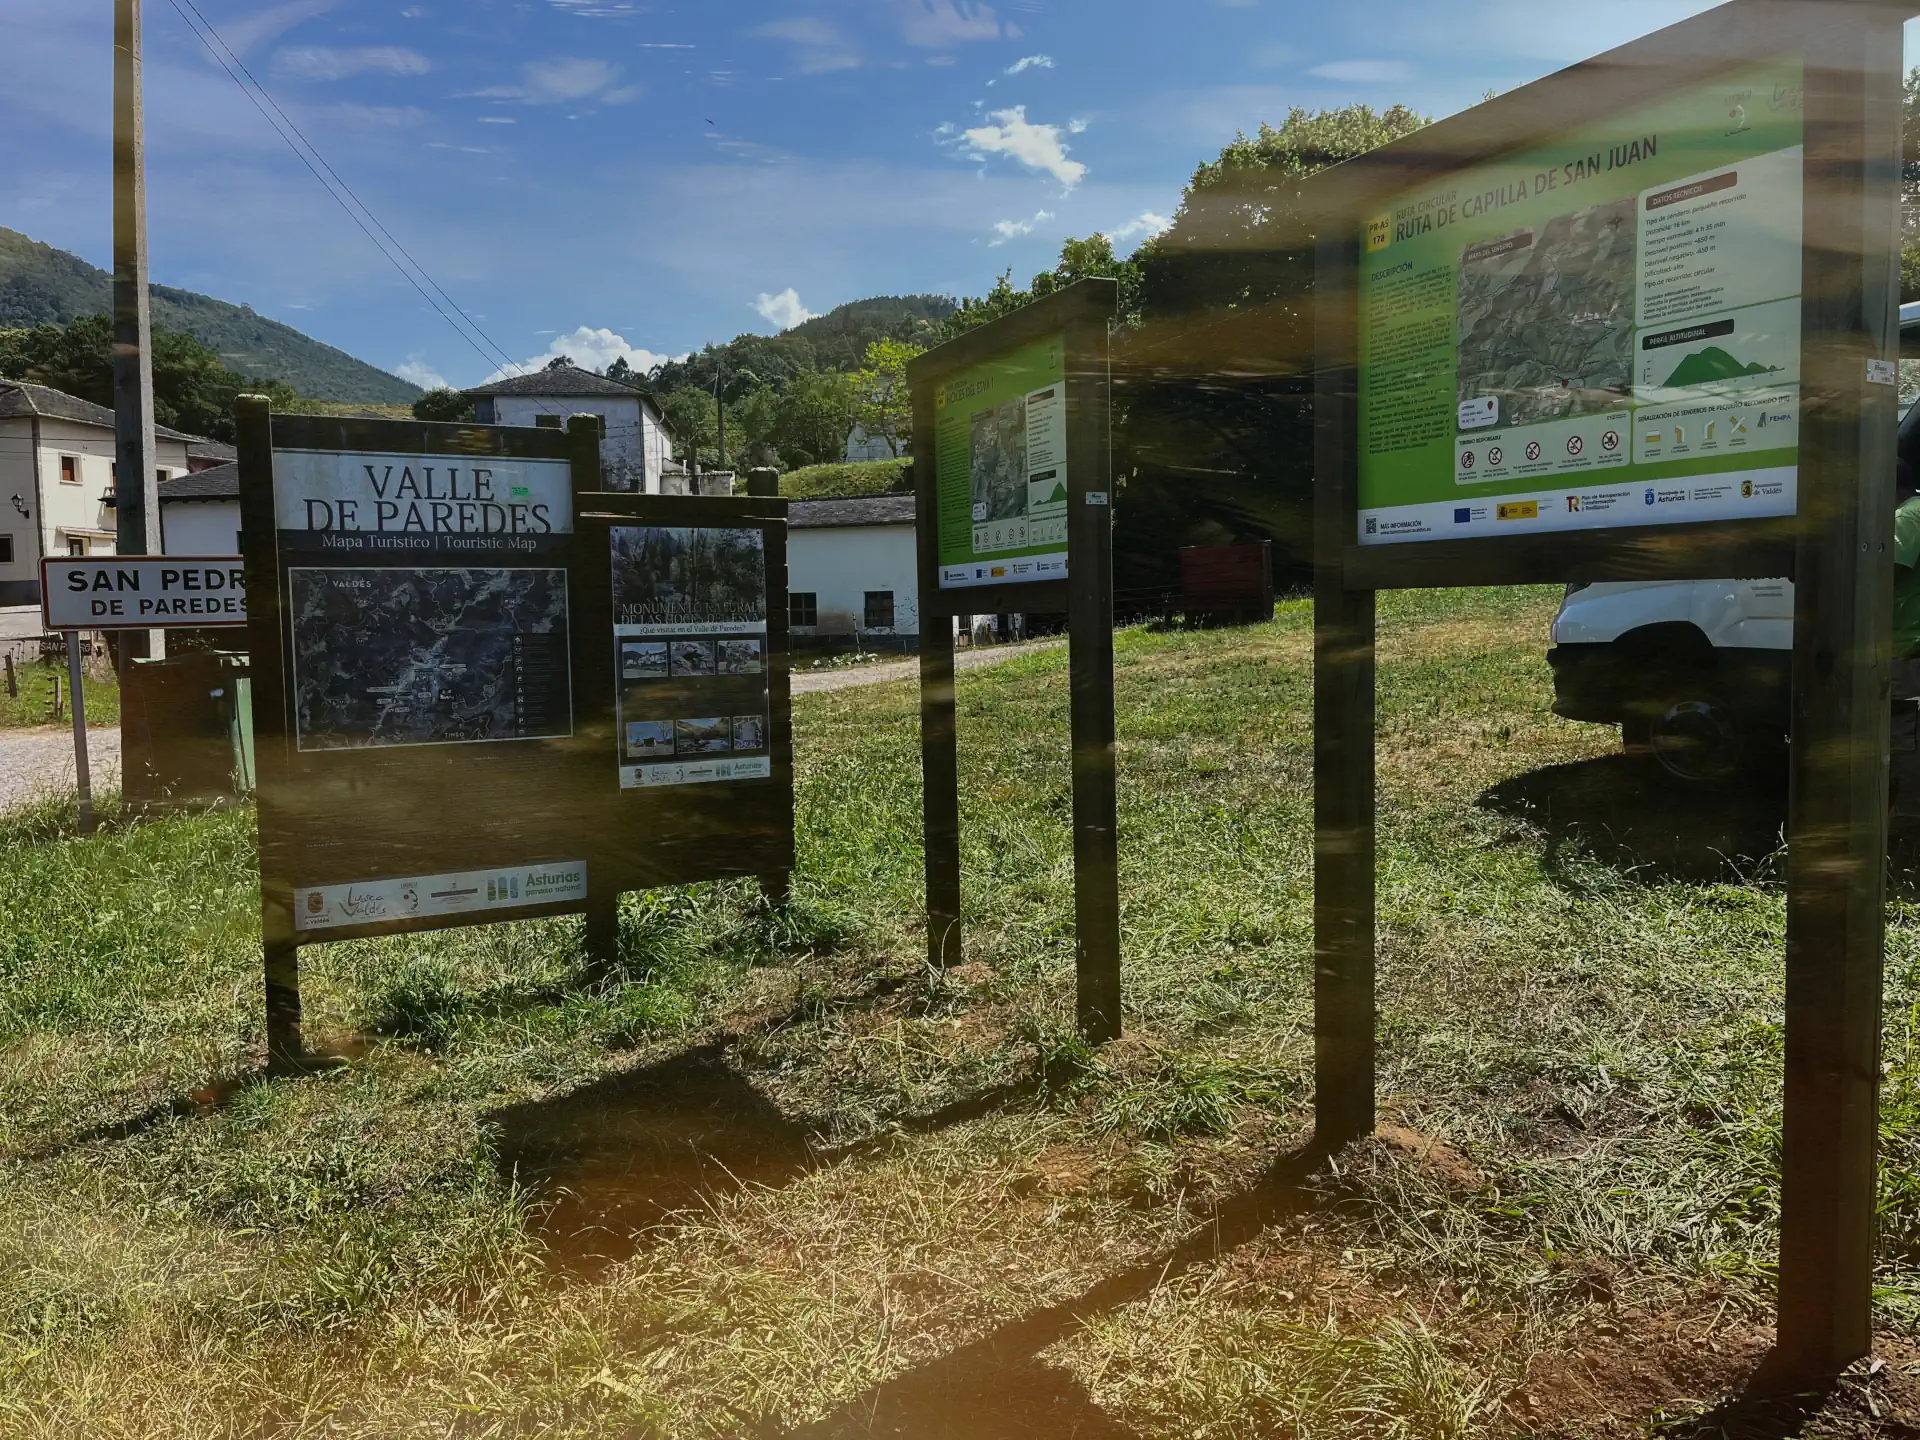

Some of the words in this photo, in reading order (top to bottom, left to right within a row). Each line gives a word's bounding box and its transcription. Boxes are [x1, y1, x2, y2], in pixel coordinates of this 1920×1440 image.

[1396, 216, 1432, 243] RUTA
[1437, 204, 1456, 228] DE
[1462, 179, 1527, 218] CAPILLA
[1534, 168, 1557, 197] DE
[1564, 154, 1600, 185] SAN
[1607, 134, 1657, 171] JUAN
[1397, 206, 1415, 220] RUTA
[1418, 191, 1457, 213] CIRCULAR
[1369, 218, 1389, 234] PR-AS
[1646, 218, 1658, 226] Tipo
[1714, 221, 1725, 229] min
[1372, 234, 1385, 245] 178
[1372, 261, 1412, 281] DESCRIPCIÓN
[1694, 267, 1715, 277] circular
[1650, 336, 1668, 345] PERFIL
[1669, 329, 1706, 341] ALTITUDINAL
[1680, 406, 1707, 416] SENDEROS
[363, 465, 495, 500] VALLE
[1657, 495, 1685, 503] Asturias
[303, 499, 361, 532] DE
[373, 501, 552, 534] PAREDES
[322, 534, 363, 552] Mapa
[444, 535, 503, 549] Touristic
[508, 536, 537, 552] Map
[68, 569, 140, 592] SAN
[162, 569, 245, 591] PEDR
[332, 579, 372, 588] VALDÉS
[91, 600, 124, 616] DE
[622, 603, 702, 615] MONUMENTO
[705, 601, 756, 613] NATURAL
[621, 615, 637, 624] DE
[640, 614, 661, 624] LAS
[657, 625, 676, 633] visitar
[687, 625, 693, 633] el
[694, 624, 709, 632] Valle
[41, 641, 59, 652] SAN
[526, 872, 580, 887] Asturias
[555, 884, 580, 893] natural
